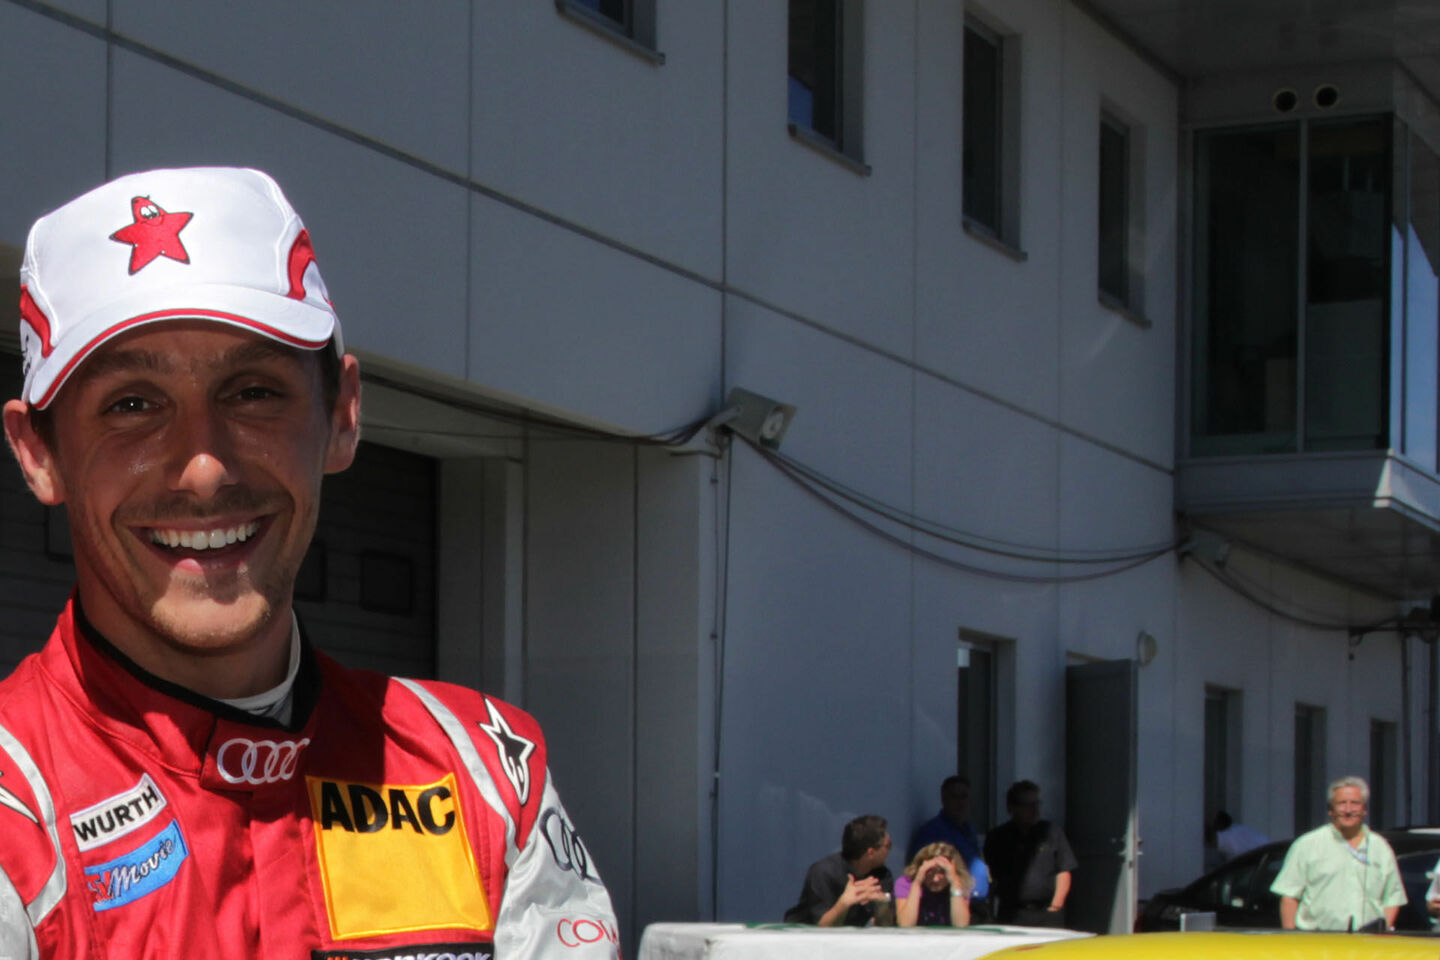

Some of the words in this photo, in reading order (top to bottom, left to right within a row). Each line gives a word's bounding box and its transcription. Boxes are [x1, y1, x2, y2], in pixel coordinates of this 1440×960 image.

[73, 785, 159, 841] WURTH
[320, 782, 456, 836] ADAC
[109, 834, 176, 897] Movie
